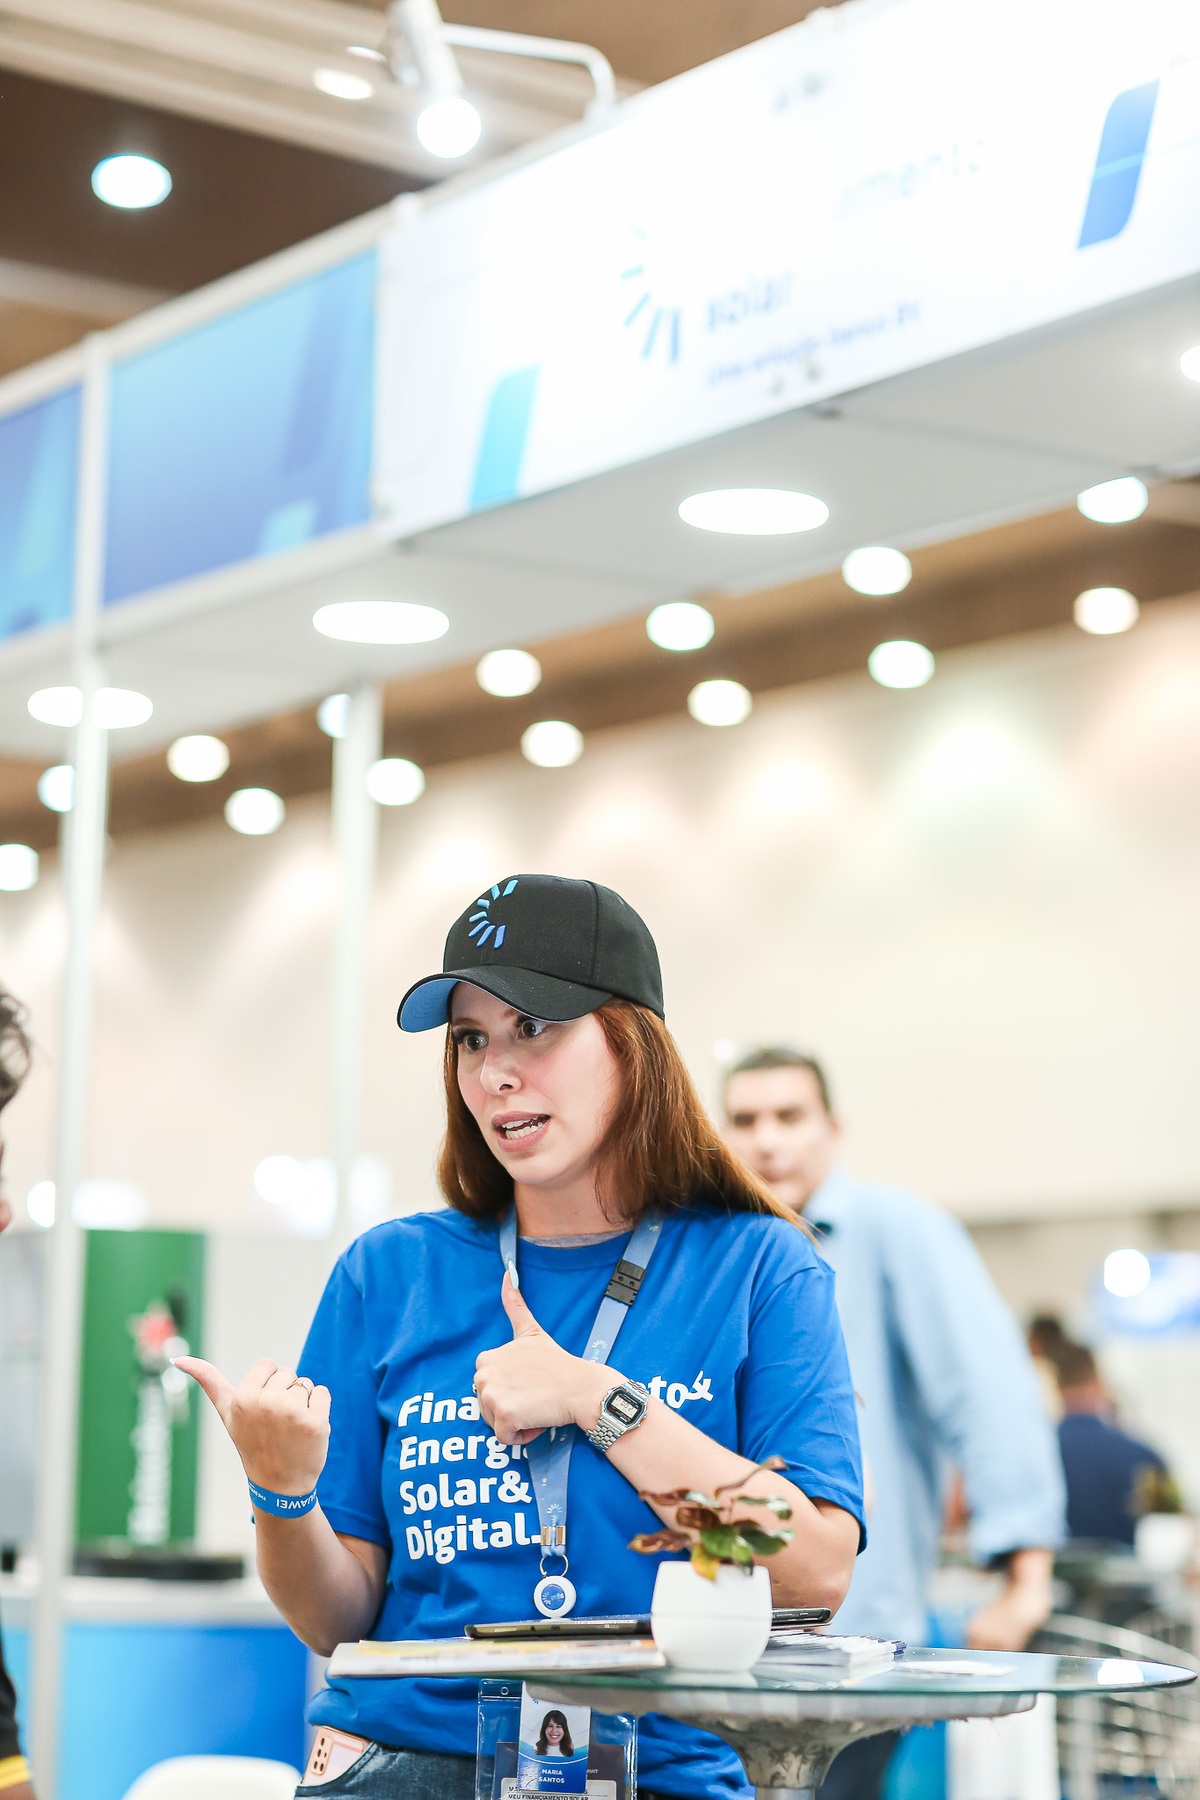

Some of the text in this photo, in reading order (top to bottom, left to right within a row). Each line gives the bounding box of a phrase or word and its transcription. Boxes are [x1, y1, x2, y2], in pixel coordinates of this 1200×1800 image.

[398, 1392, 481, 1427] Fina
[638, 1370, 714, 1409] to&
[399, 1435, 529, 1470] Energ
[400, 1470, 533, 1515] Solar&
[405, 1512, 542, 1565] Digital.
